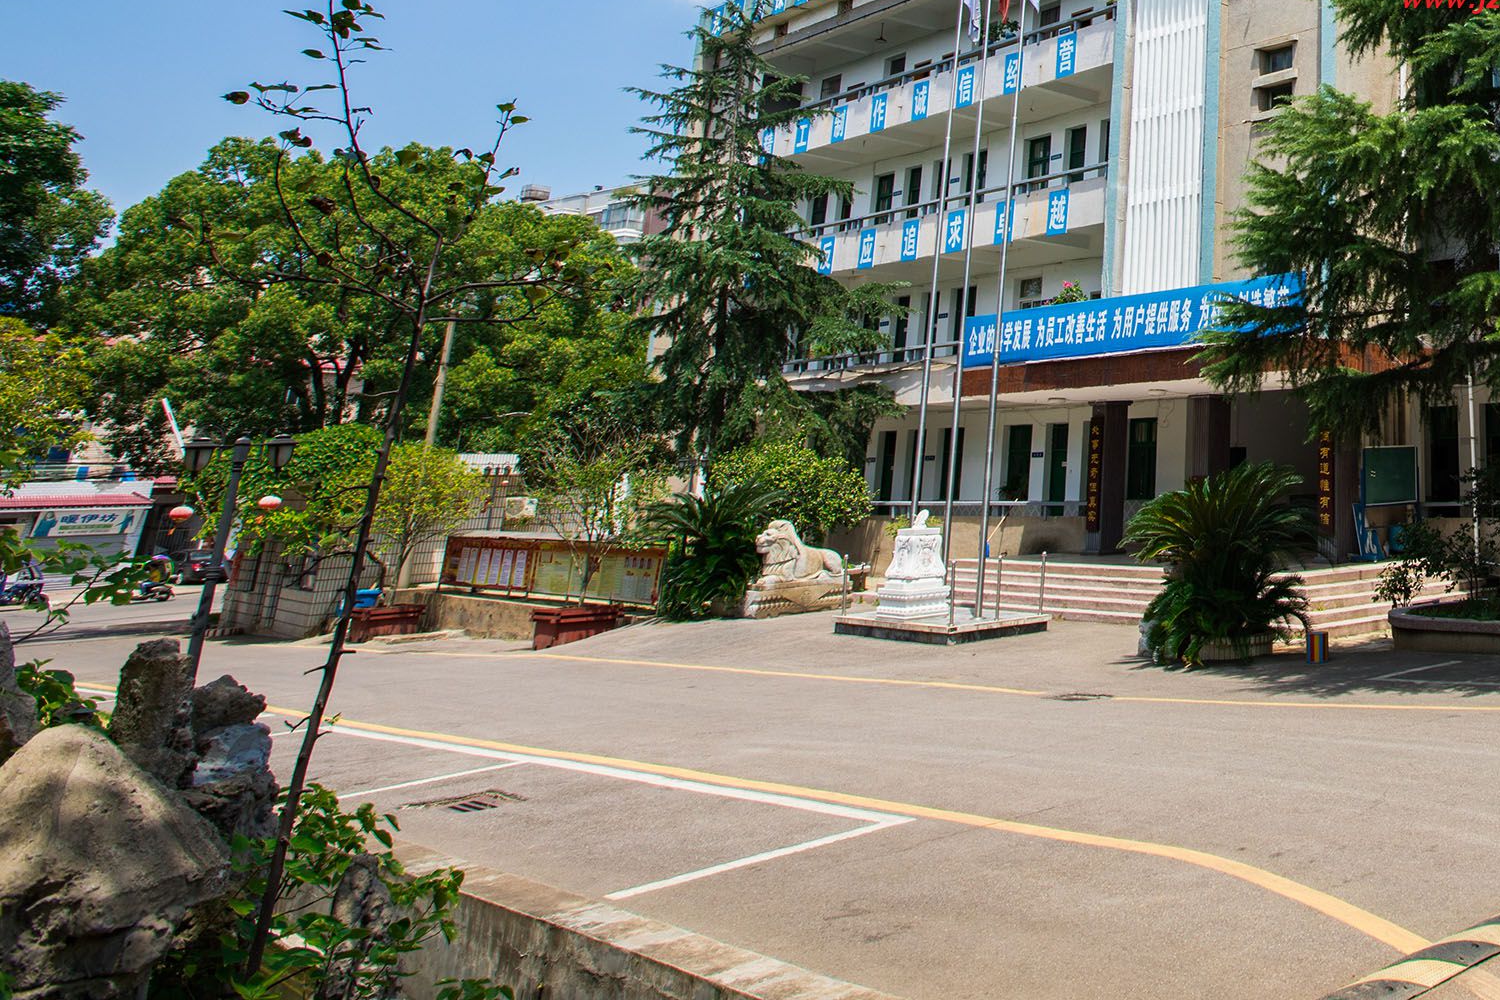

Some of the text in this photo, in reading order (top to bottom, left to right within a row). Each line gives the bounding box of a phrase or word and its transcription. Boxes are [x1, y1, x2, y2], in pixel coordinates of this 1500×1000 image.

[1035, 309, 1108, 348] 为员工改善生活
[1111, 297, 1192, 339] 为用户提供服务
